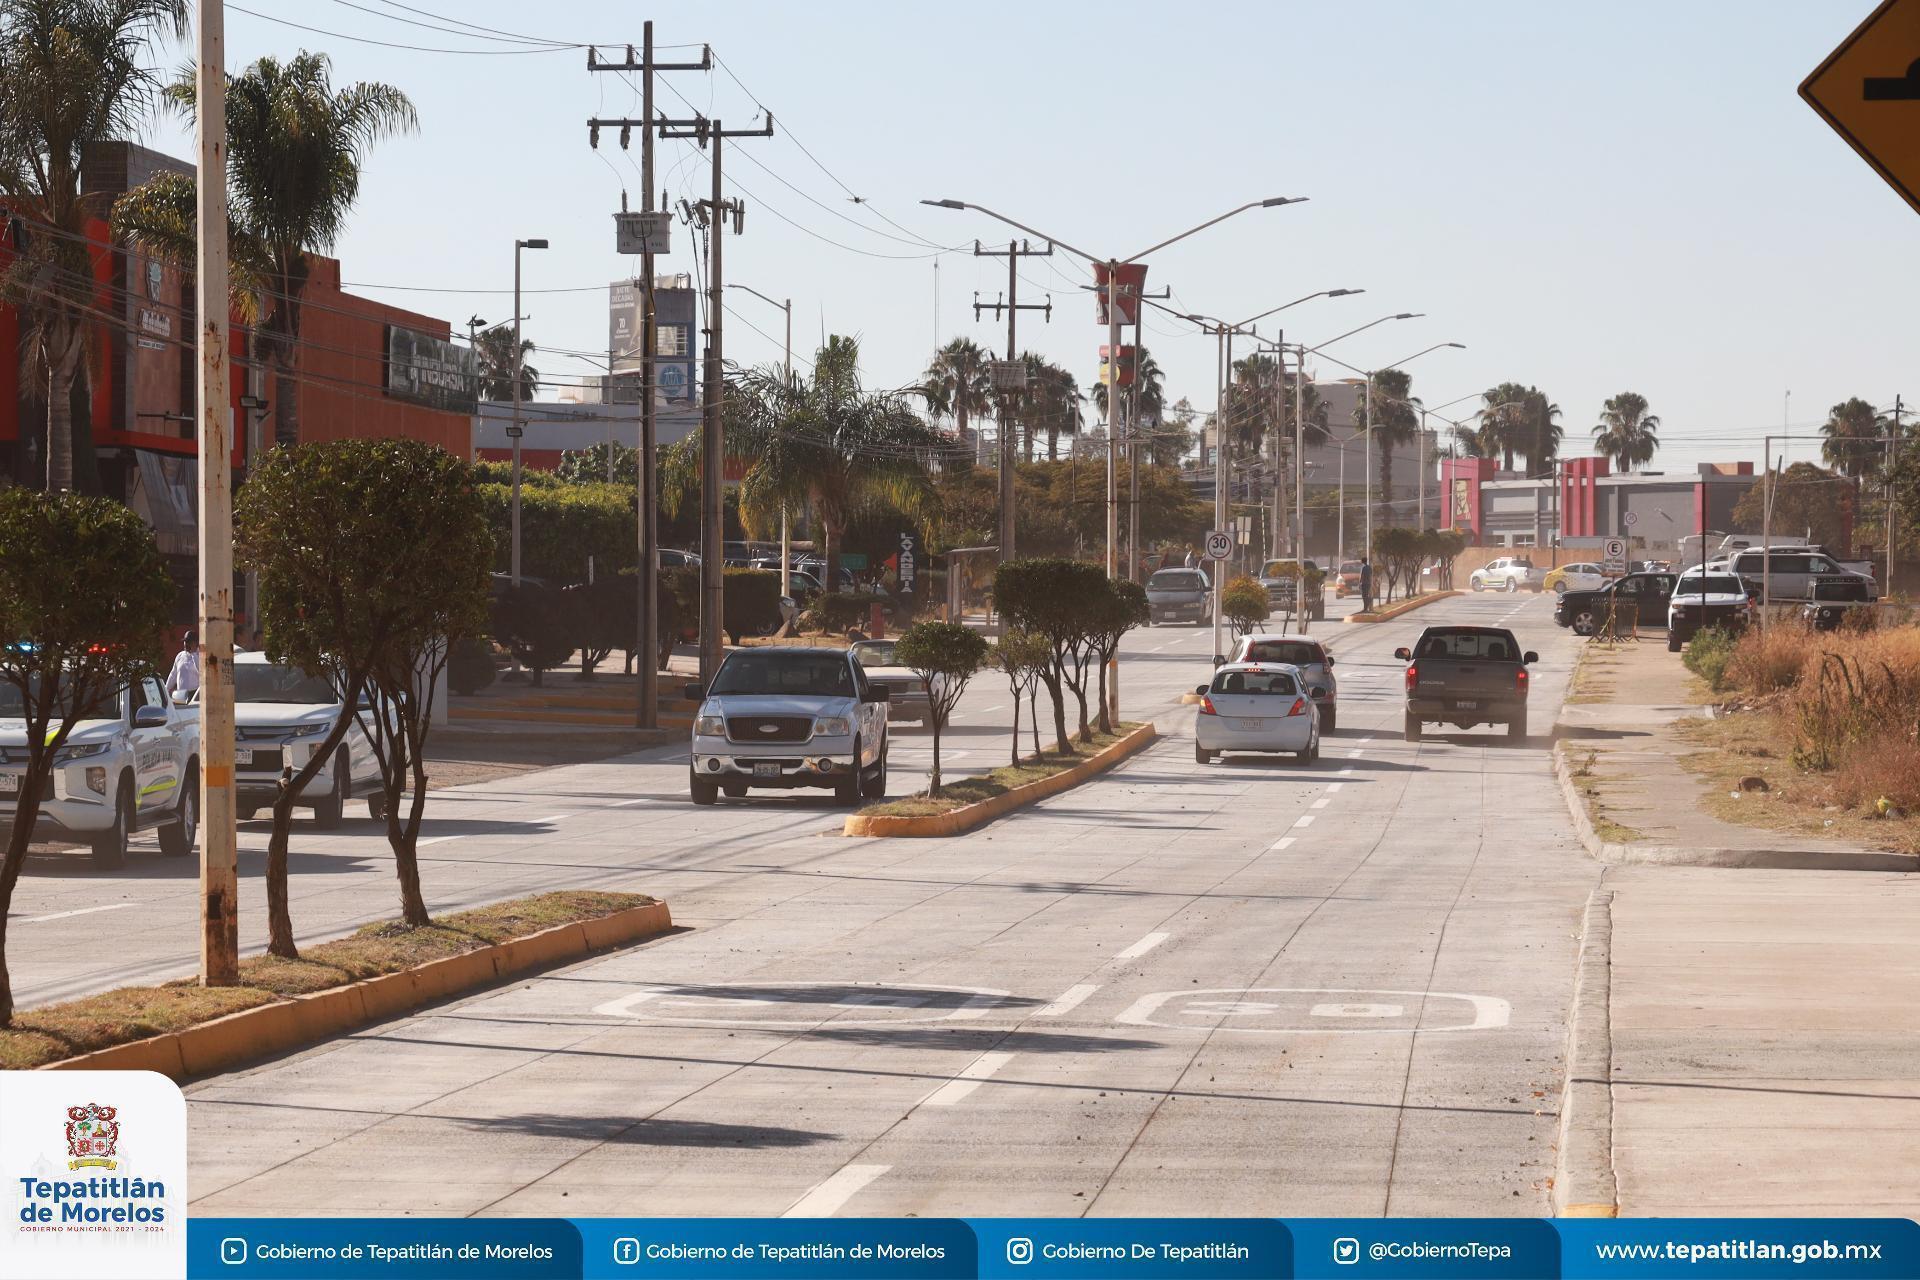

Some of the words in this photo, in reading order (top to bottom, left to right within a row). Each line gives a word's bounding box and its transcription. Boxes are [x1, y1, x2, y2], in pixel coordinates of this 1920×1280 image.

[1212, 537, 1227, 549] 30
[1611, 543, 1619, 553] E
[900, 532, 914, 593] LAVANDERIA
